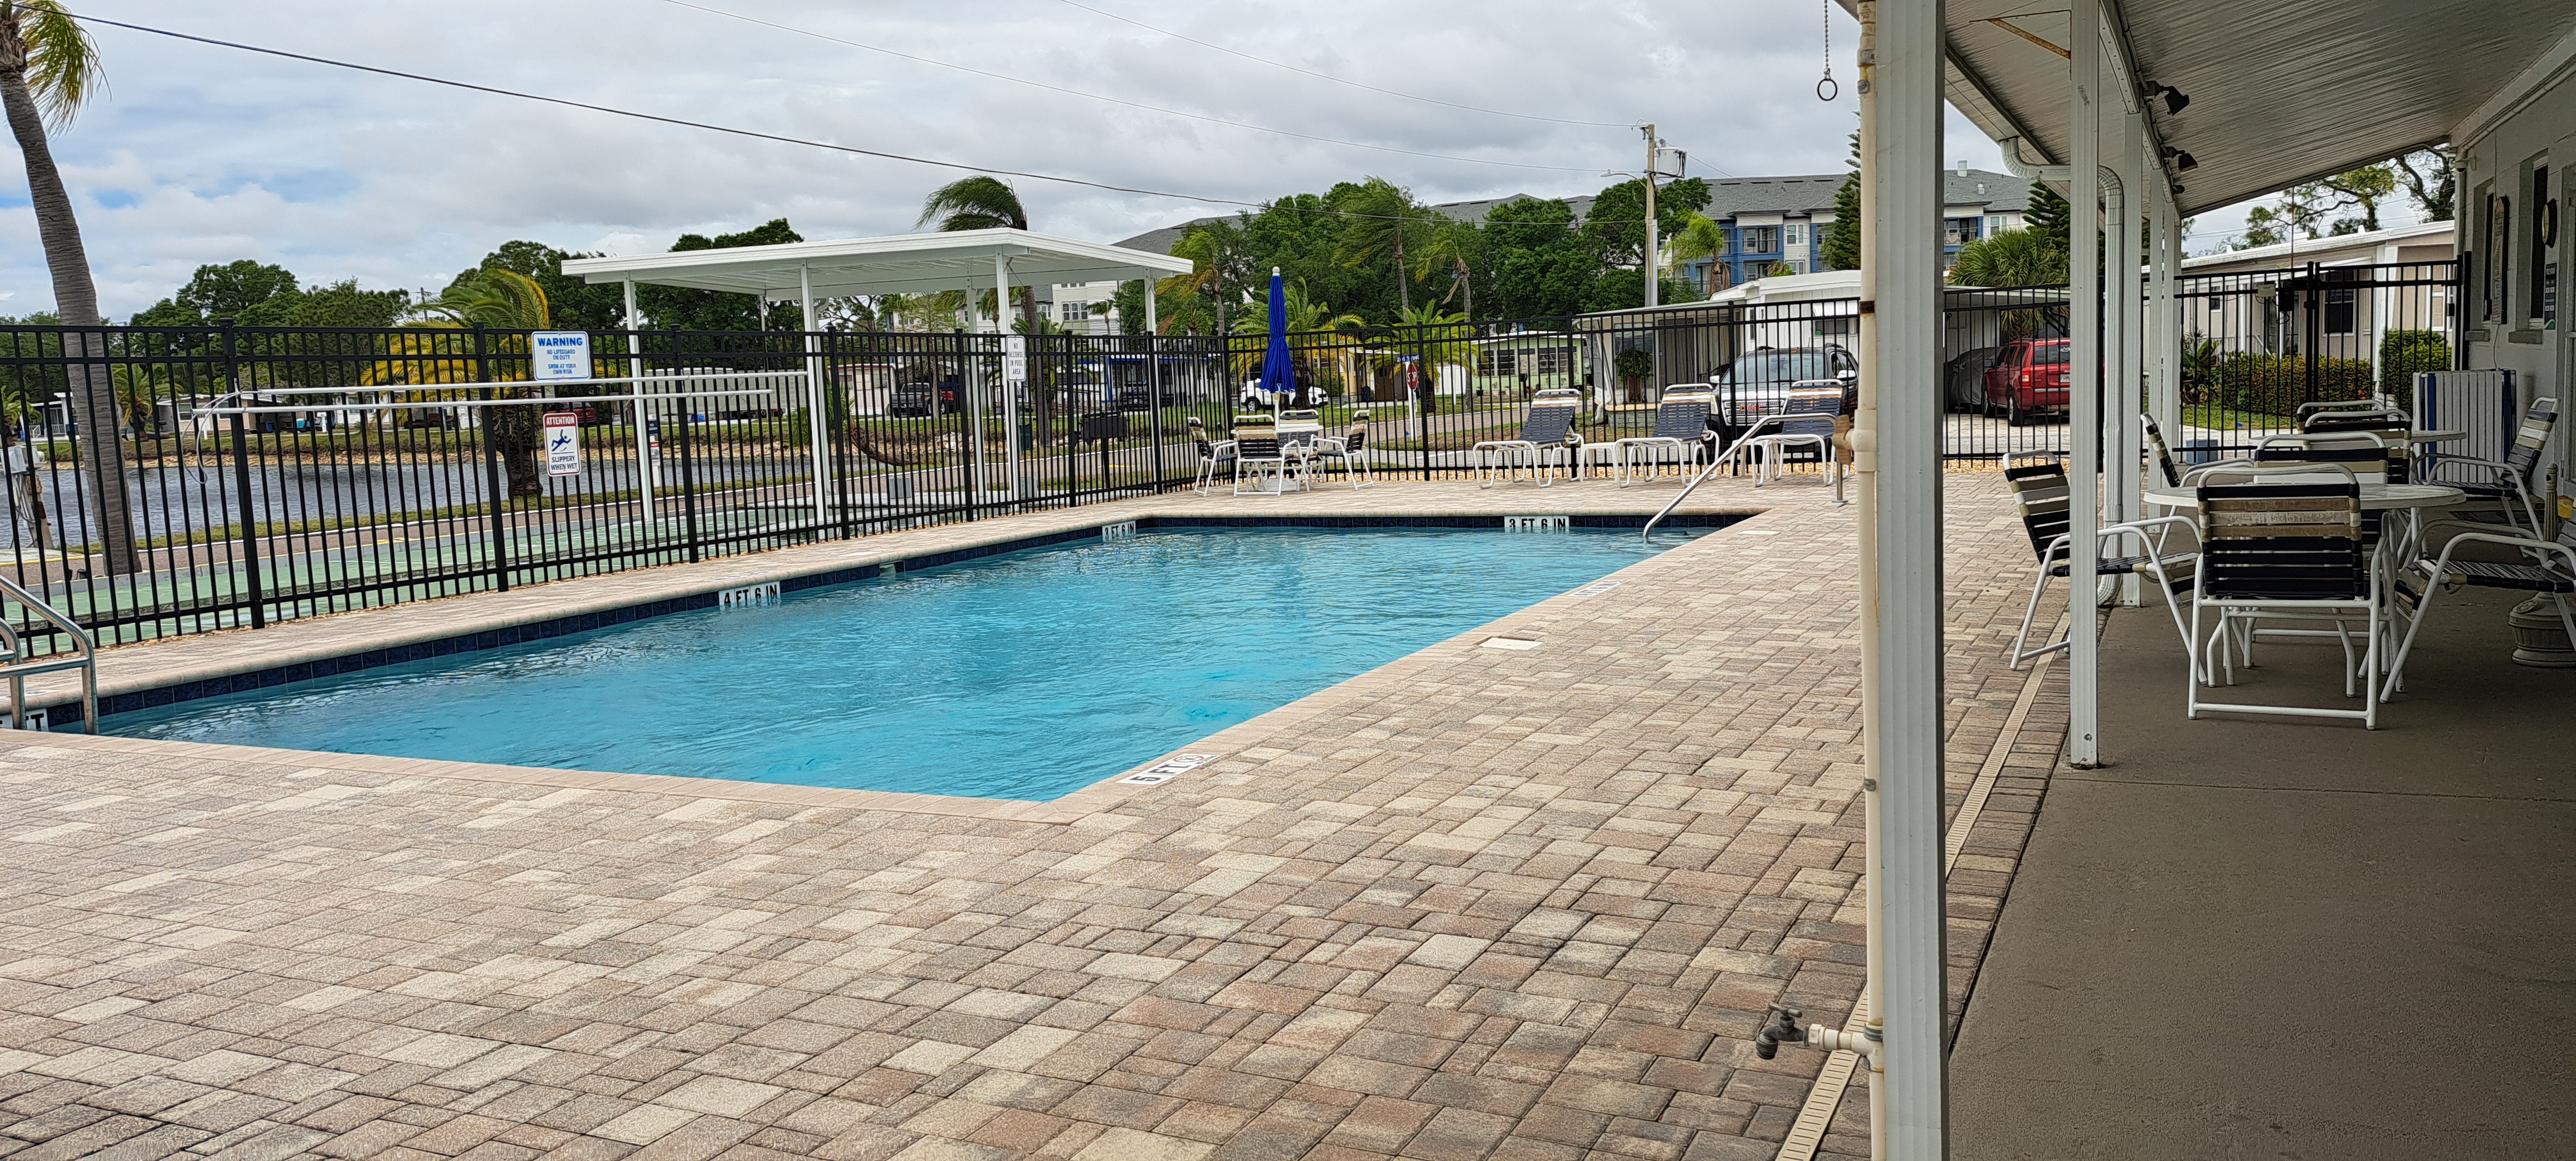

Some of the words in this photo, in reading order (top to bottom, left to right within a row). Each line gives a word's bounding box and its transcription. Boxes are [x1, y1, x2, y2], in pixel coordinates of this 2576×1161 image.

[538, 338, 583, 347] WARNING
[547, 416, 574, 425] ATTENTION
[1128, 523, 1134, 537] IN
[1509, 519, 1515, 533] 3
[1521, 519, 1535, 533] FT
[1541, 519, 1548, 534] 6
[1553, 518, 1565, 533] IN
[724, 592, 731, 608] 4
[736, 589, 749, 607] FT
[755, 587, 762, 606] 6
[765, 584, 777, 606] IN
[1147, 764, 1191, 774] FT
